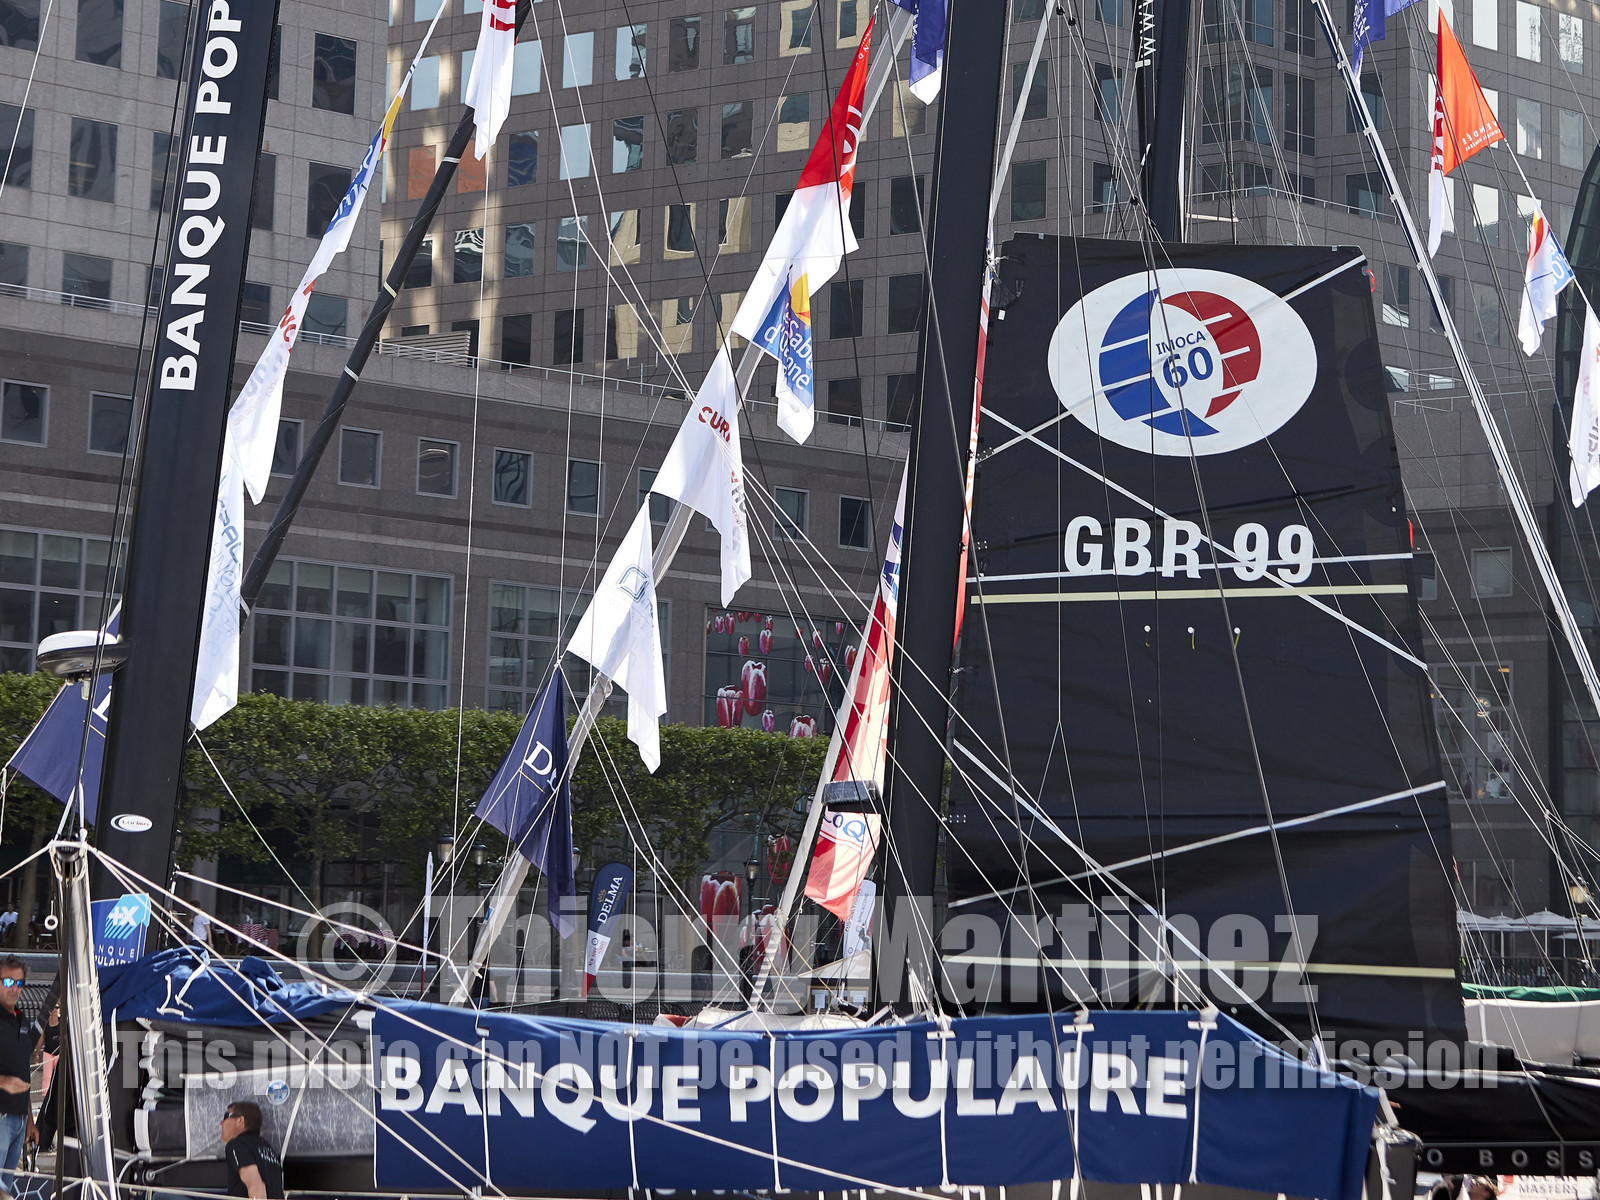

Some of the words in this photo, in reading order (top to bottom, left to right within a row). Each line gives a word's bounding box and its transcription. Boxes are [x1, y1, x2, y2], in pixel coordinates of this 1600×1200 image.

[159, 135, 228, 391] BANQUE
[1155, 330, 1206, 355] IMOCA
[1162, 346, 1213, 388] 60
[1064, 515, 1202, 579] GBR
[1232, 522, 1314, 584] 99
[597, 876, 624, 925] DELMA
[381, 1055, 701, 1135] BANQUE
[729, 1052, 1189, 1123] POPULAIRE
[1479, 1148, 1596, 1169] BOSS
